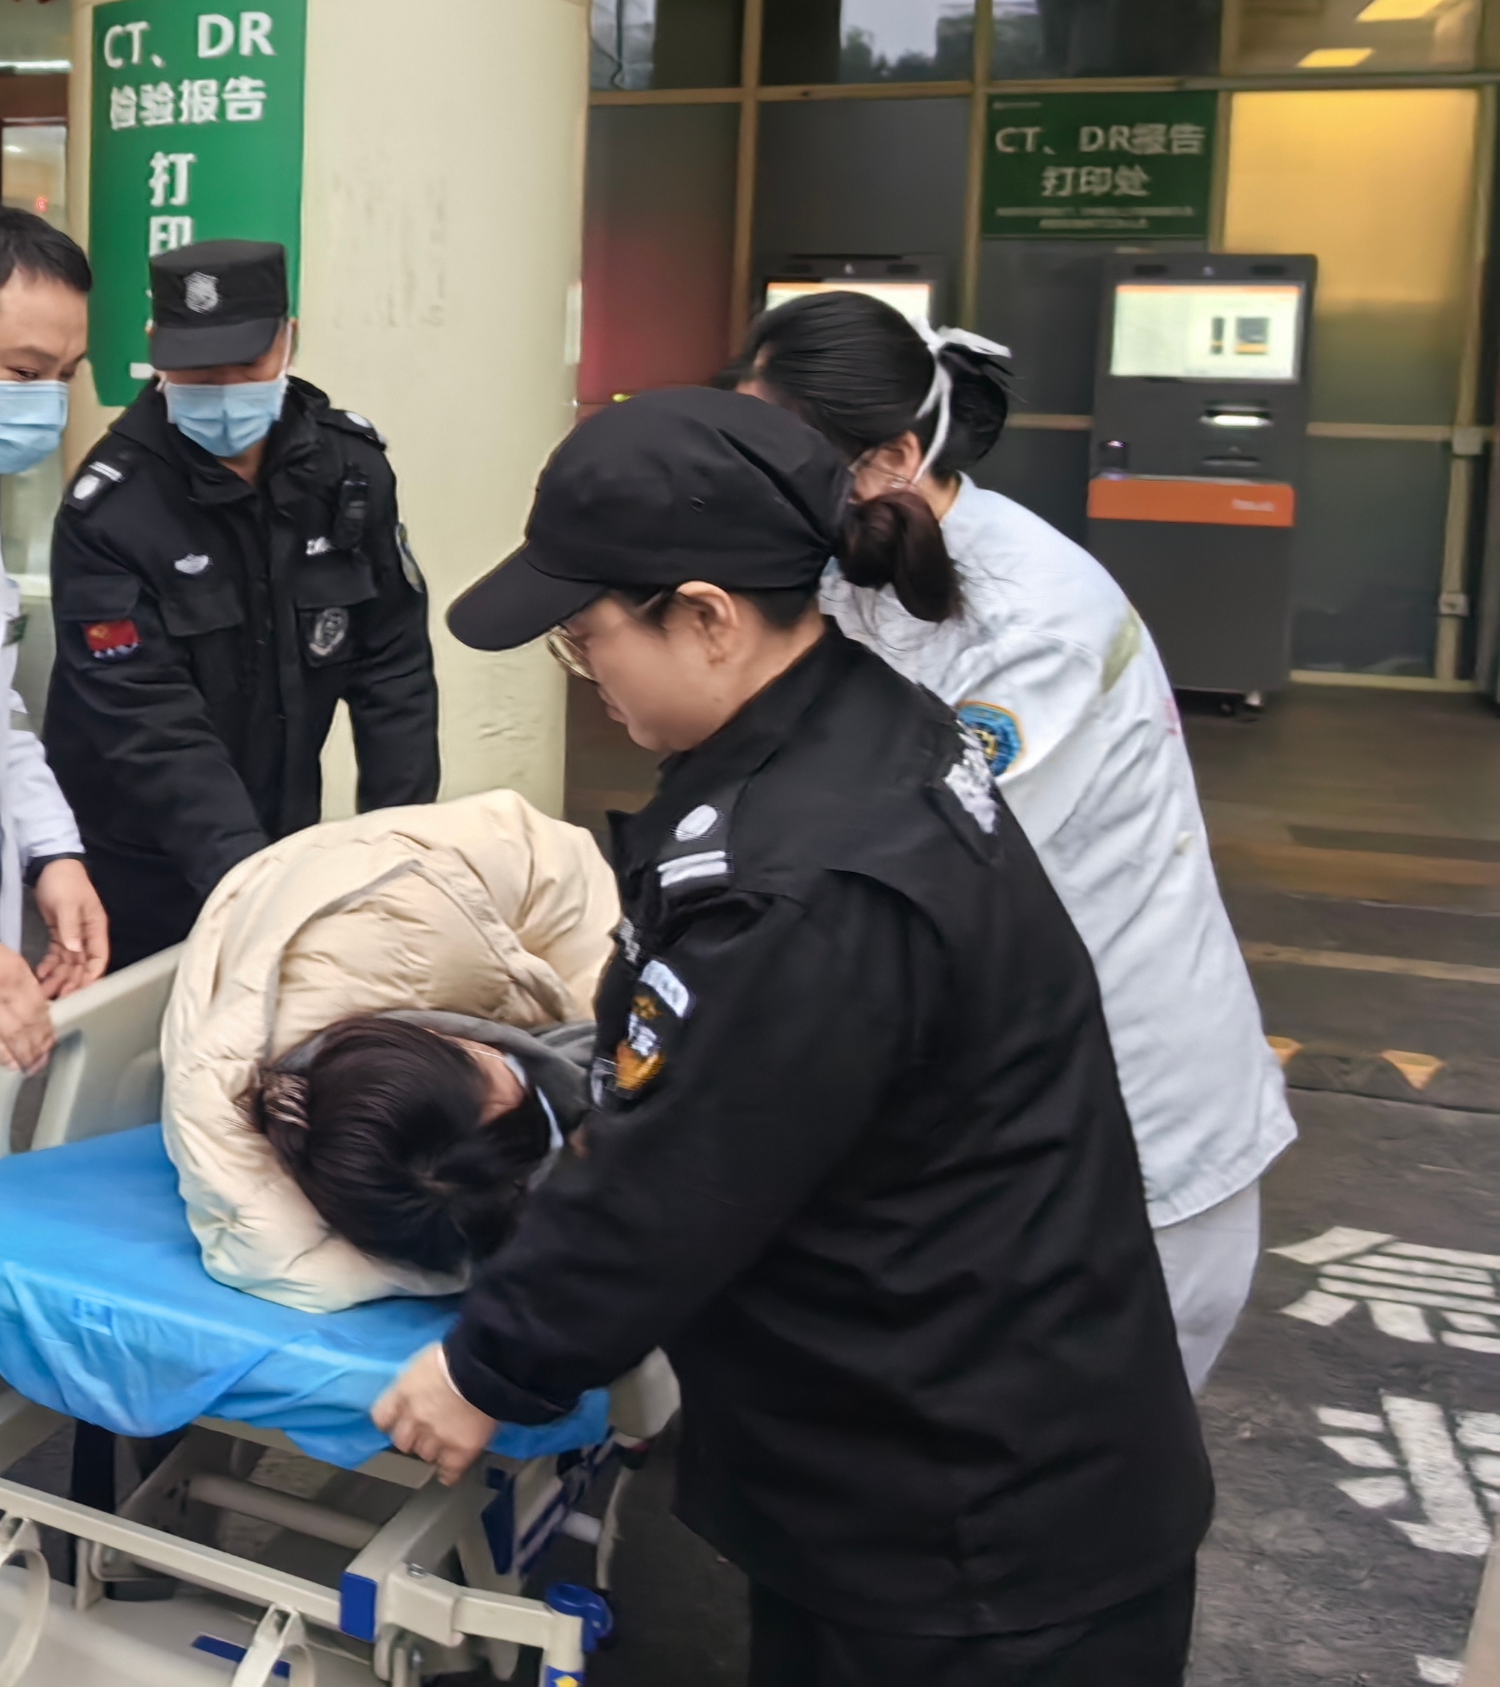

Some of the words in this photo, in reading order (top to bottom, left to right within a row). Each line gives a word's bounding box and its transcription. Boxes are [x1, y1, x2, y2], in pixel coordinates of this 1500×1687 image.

[111, 76, 268, 130] 检验报告
[1042, 165, 1151, 197] 打印处
